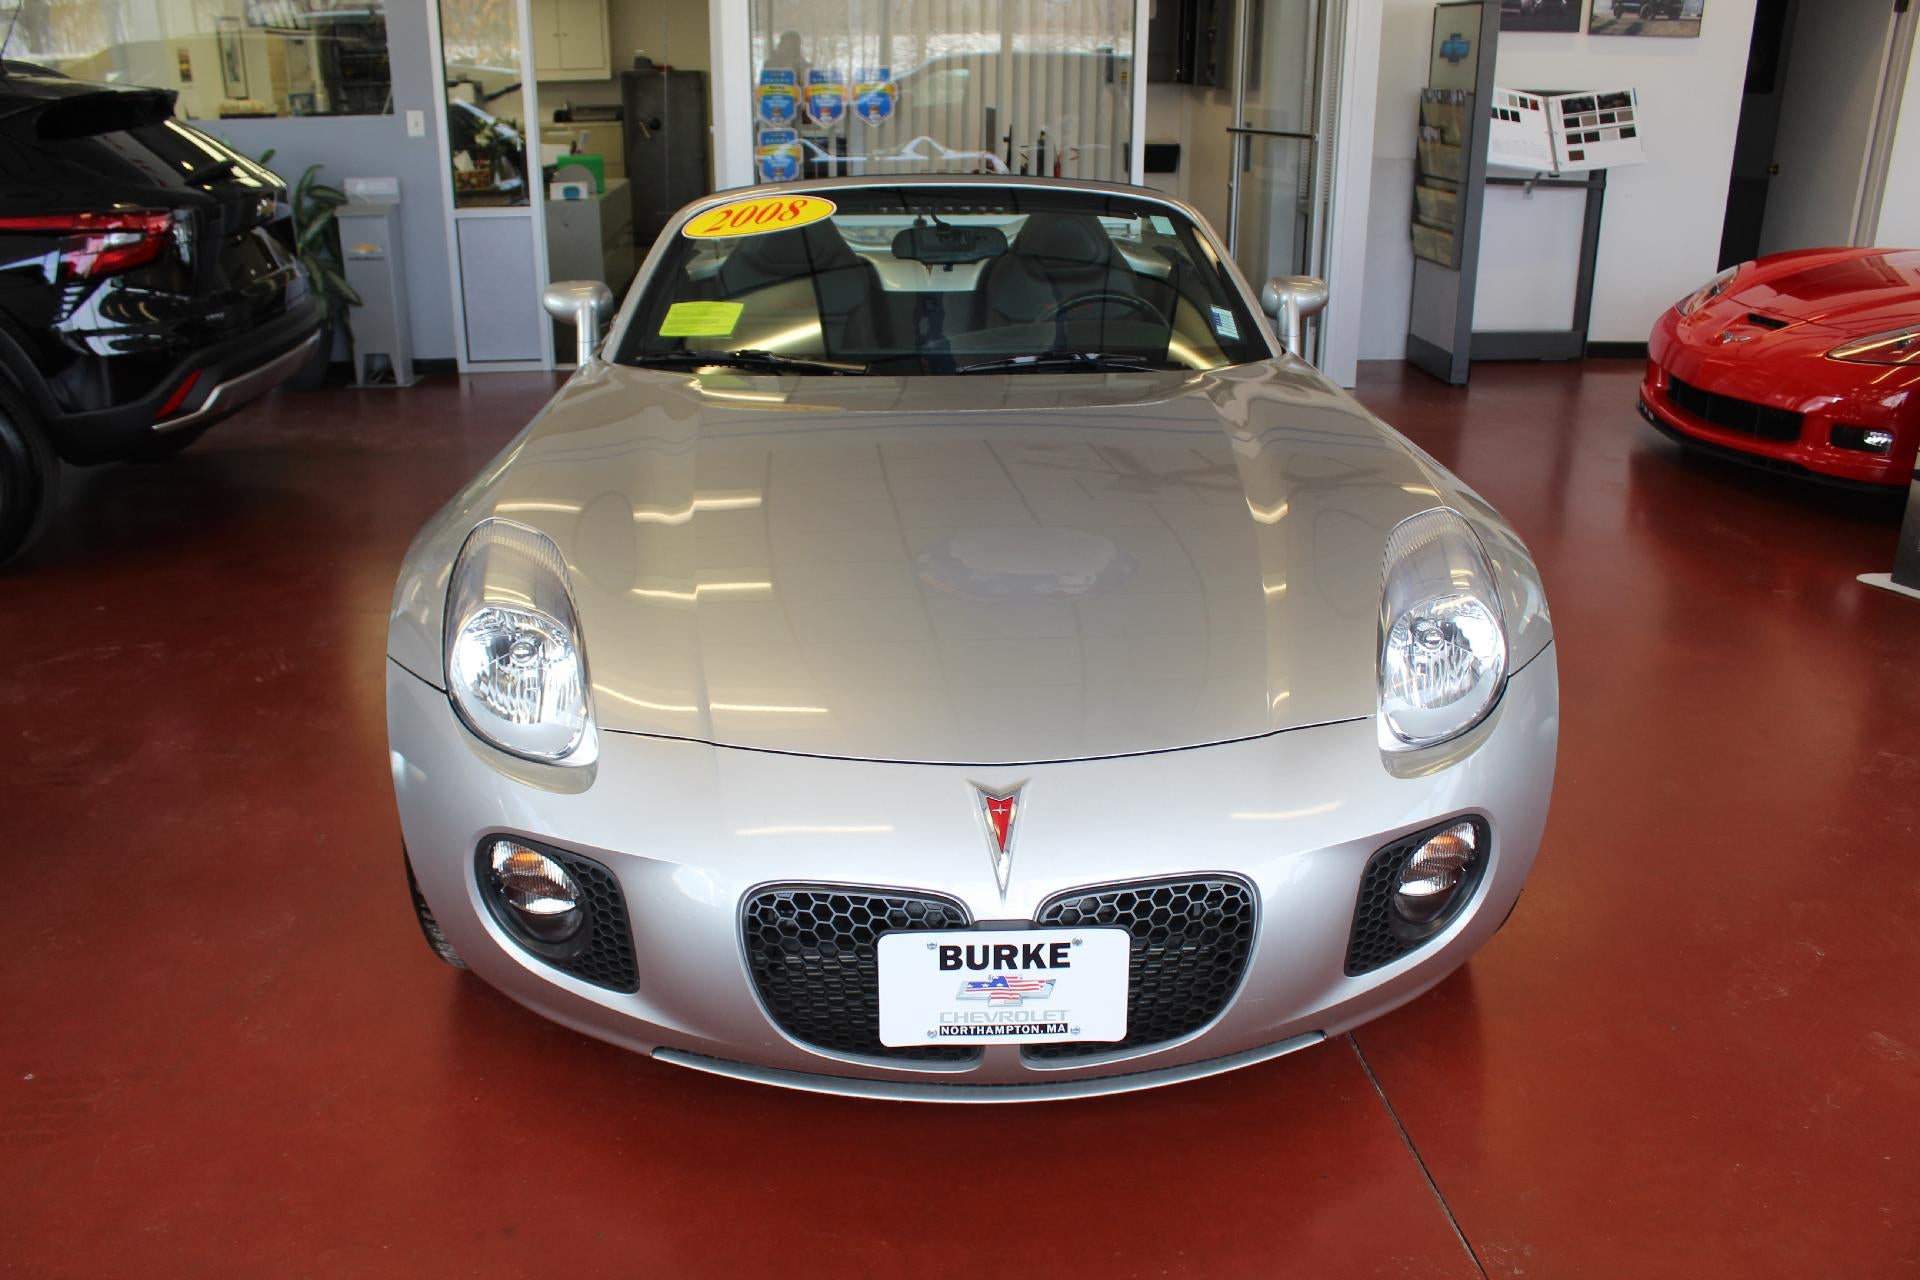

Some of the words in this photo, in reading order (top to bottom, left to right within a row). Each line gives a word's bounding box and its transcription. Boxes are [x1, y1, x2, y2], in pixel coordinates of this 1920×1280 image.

[703, 199, 808, 233] 2008
[939, 943, 1071, 970] BURKE
[939, 1010, 1070, 1023] CHEVROLET
[941, 1024, 1044, 1035] NORTHAMPTON,
[1046, 1023, 1066, 1033] MA
